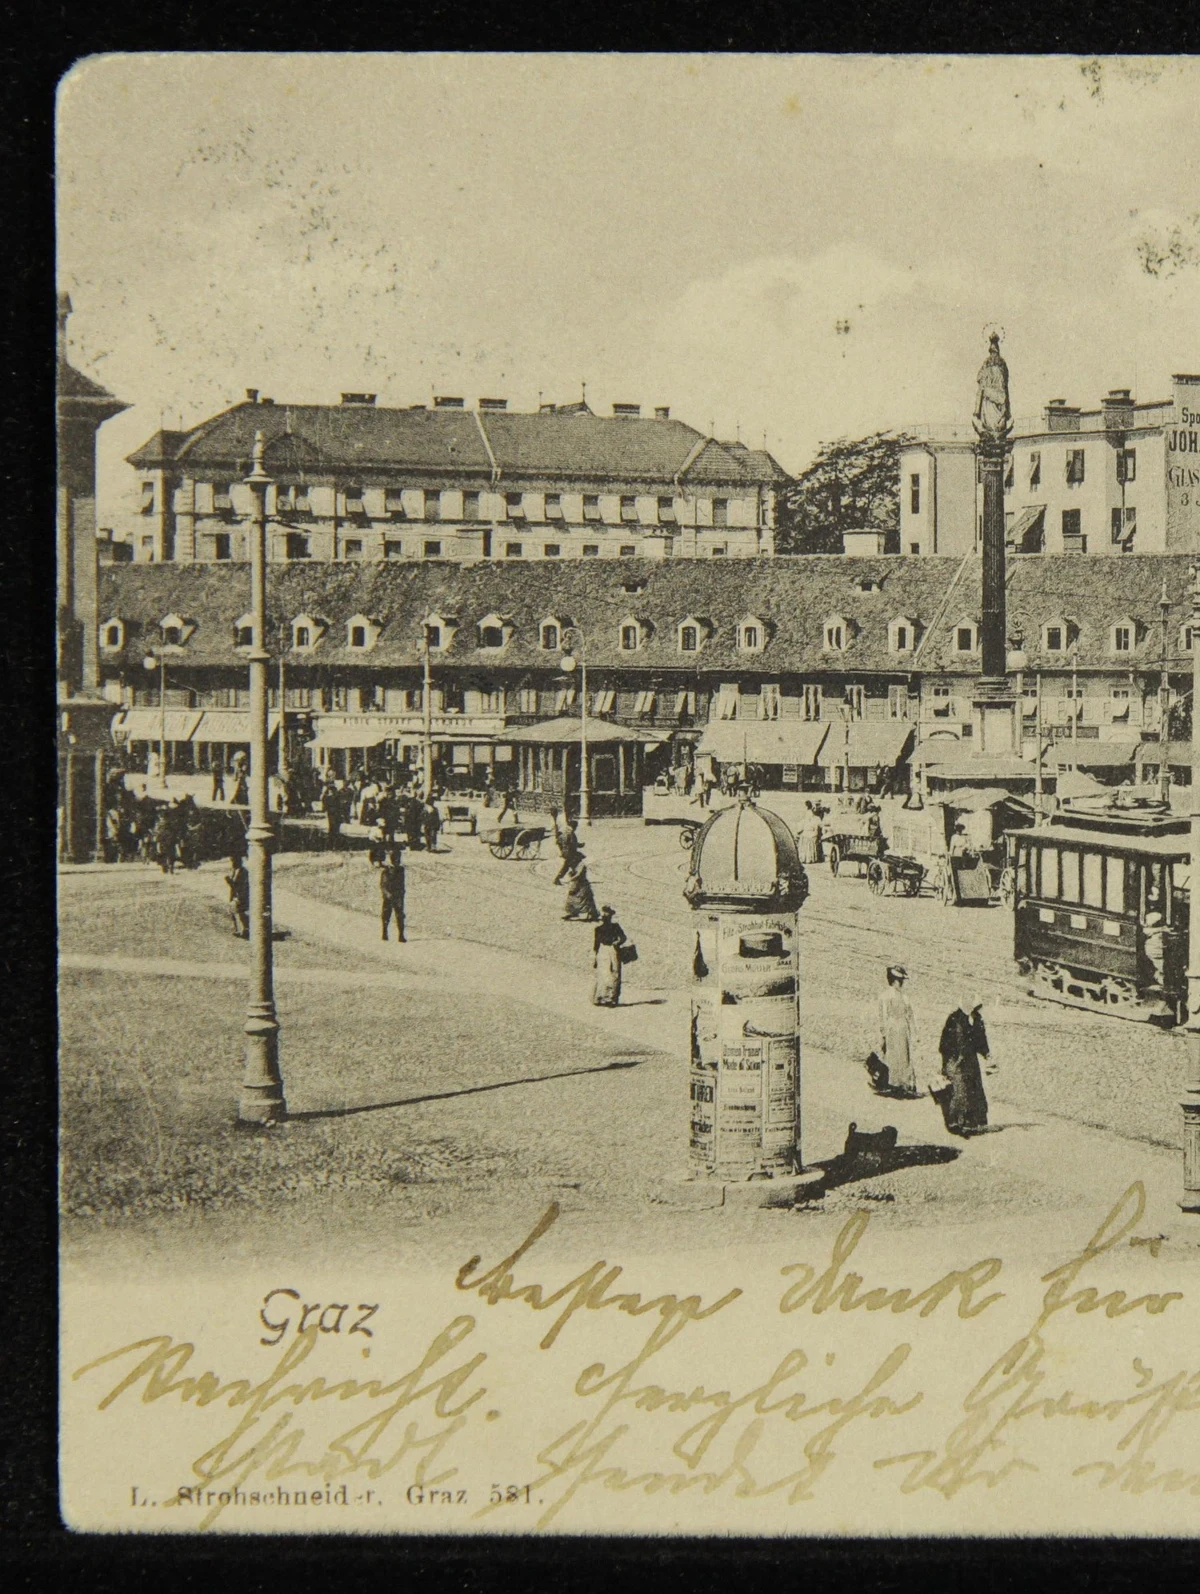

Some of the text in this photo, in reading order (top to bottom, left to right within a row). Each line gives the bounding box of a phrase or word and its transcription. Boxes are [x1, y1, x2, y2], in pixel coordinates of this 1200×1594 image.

[260, 1288, 380, 1346] Graz
[131, 1487, 157, 1507] L.
[406, 1484, 468, 1506] Graz
